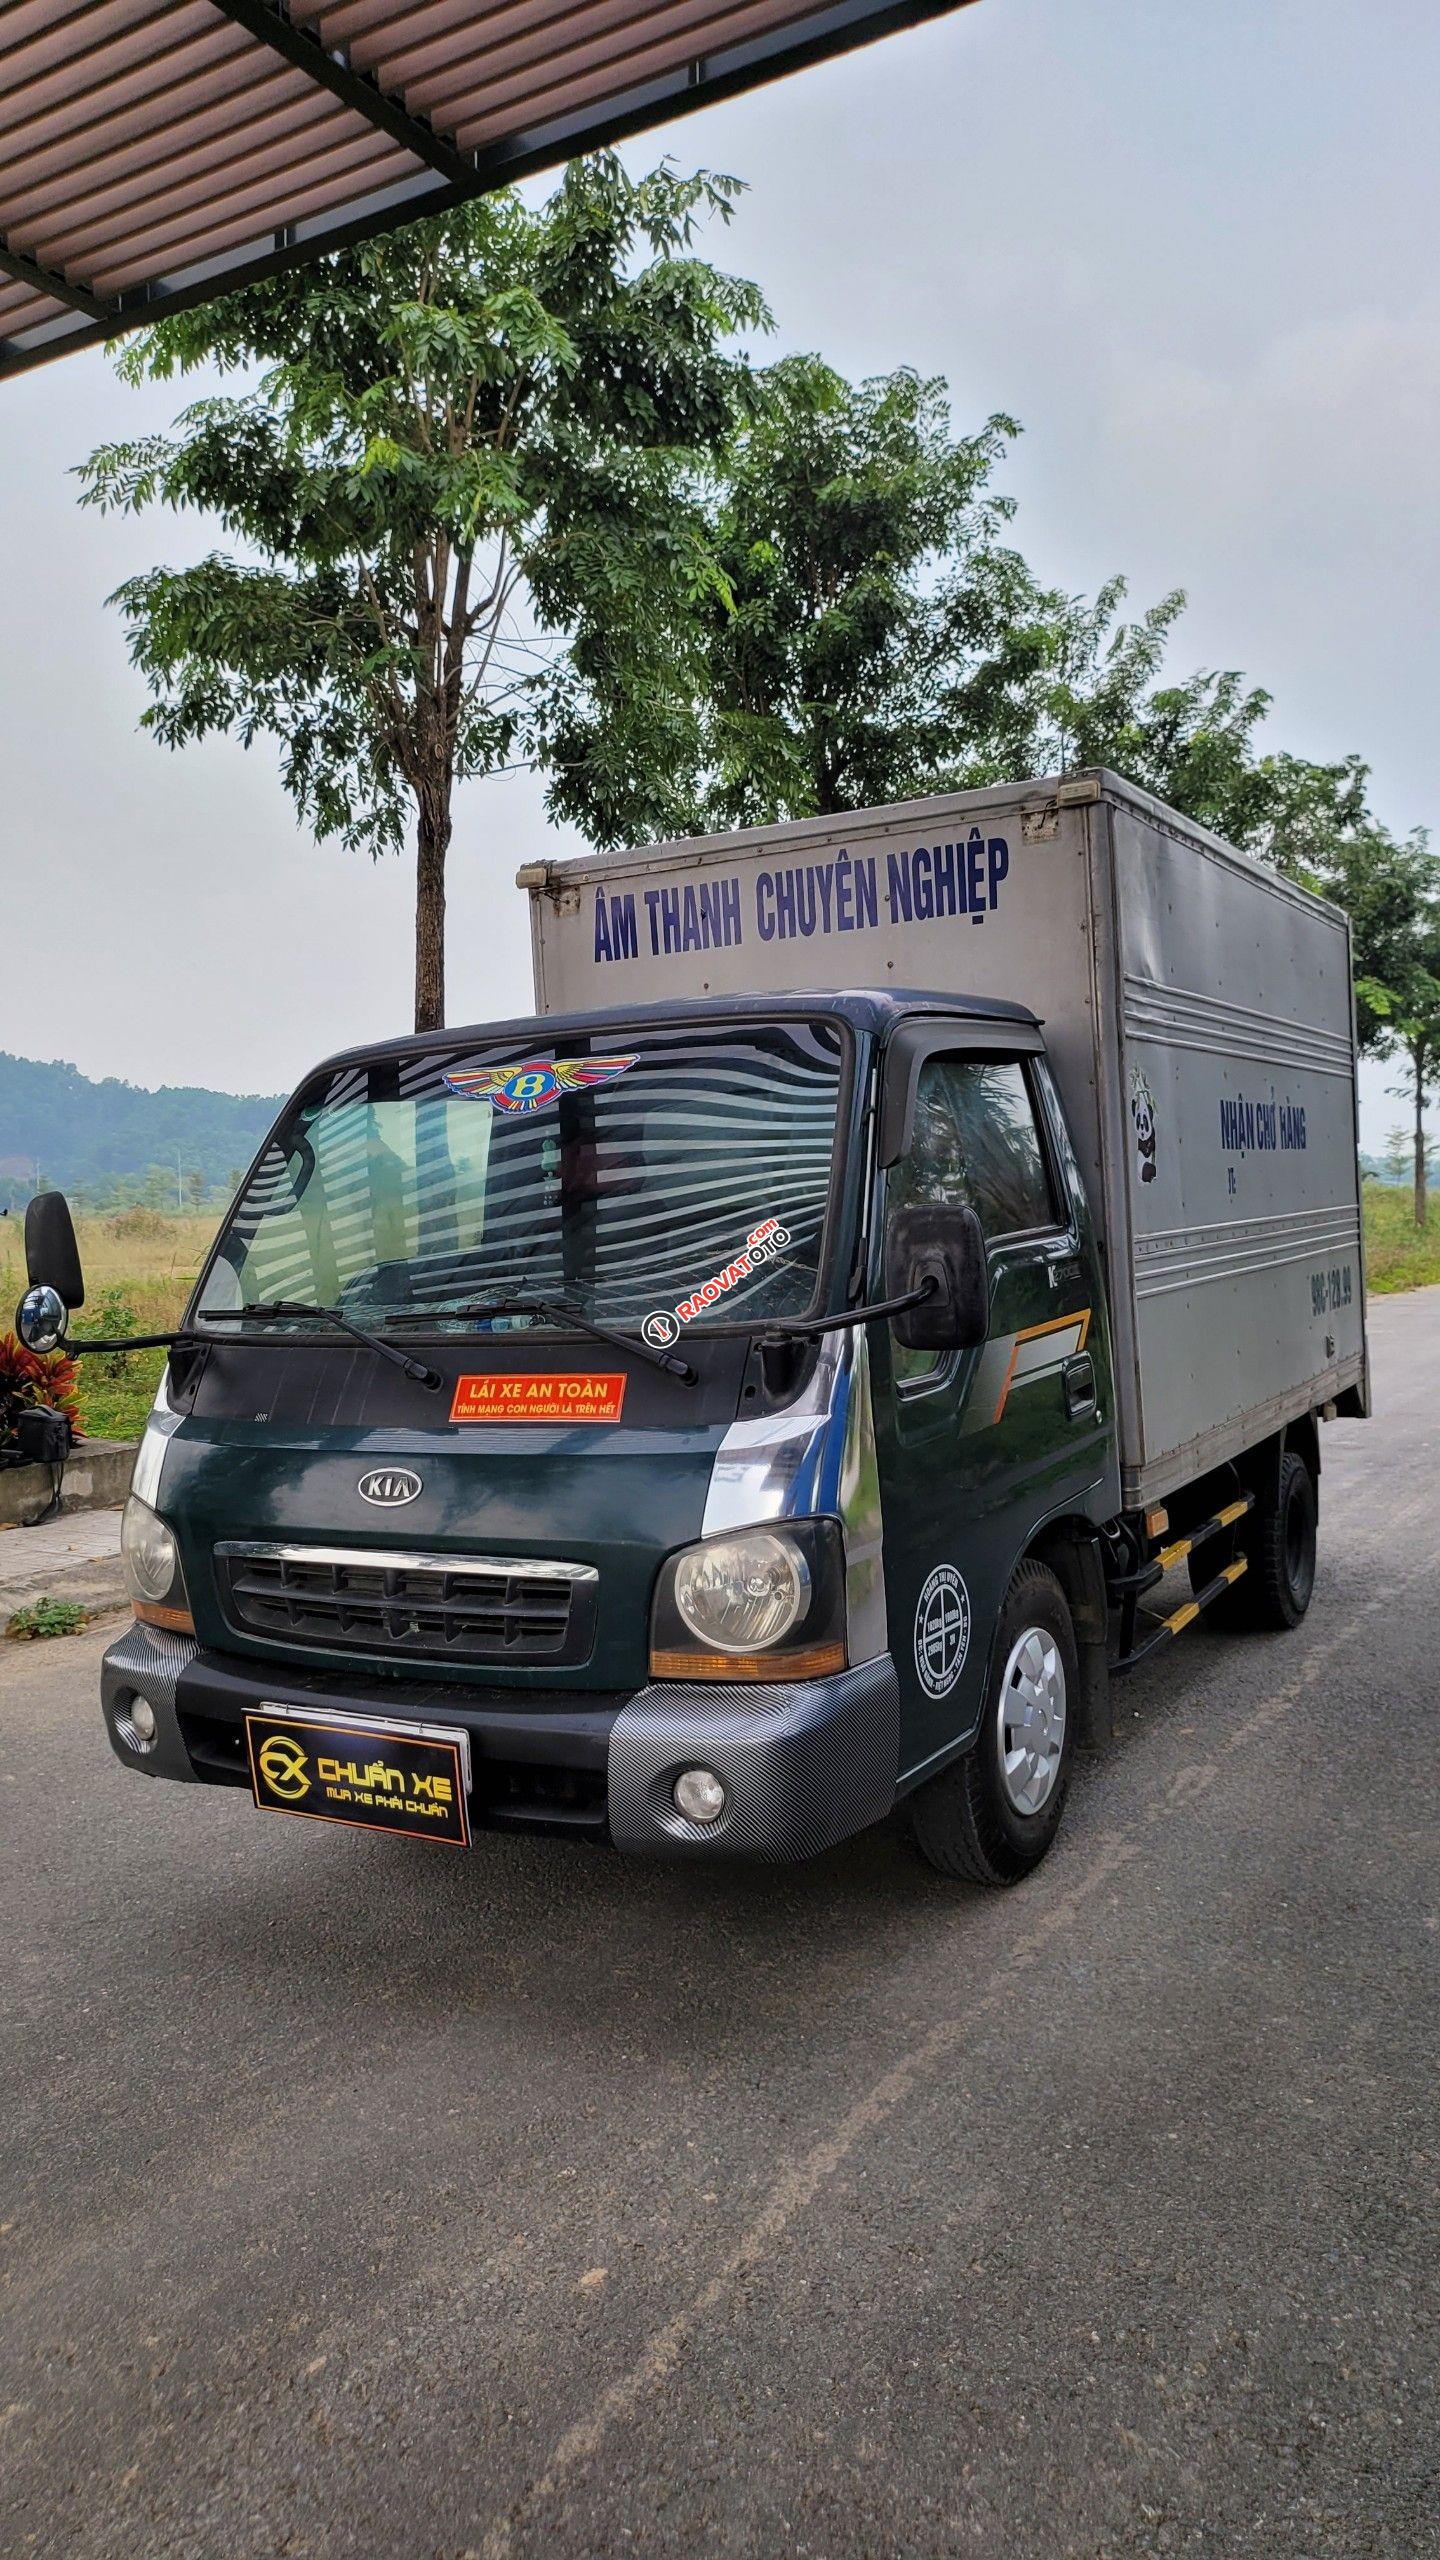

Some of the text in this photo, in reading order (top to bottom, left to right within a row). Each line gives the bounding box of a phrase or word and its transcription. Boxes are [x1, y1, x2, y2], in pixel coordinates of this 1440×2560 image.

[594, 827, 1009, 963] ÂM THANH CHUYÊN NGHIỆP
[1220, 1092, 1255, 1158] NHẬN
[1279, 1096, 1306, 1150] HÀNG
[470, 1378, 608, 1399] LÁI XE AN TOÀN
[478, 1404, 504, 1416] MẠNG
[507, 1404, 528, 1414] CON
[562, 1402, 573, 1414] LÀ
[575, 1402, 597, 1414] TRÊN
[598, 1401, 616, 1414] HẾT
[368, 1475, 410, 1497] KIA
[317, 1758, 452, 1801] CHUẨN XE
[326, 1786, 351, 1801] MUA
[354, 1790, 373, 1805] XE
